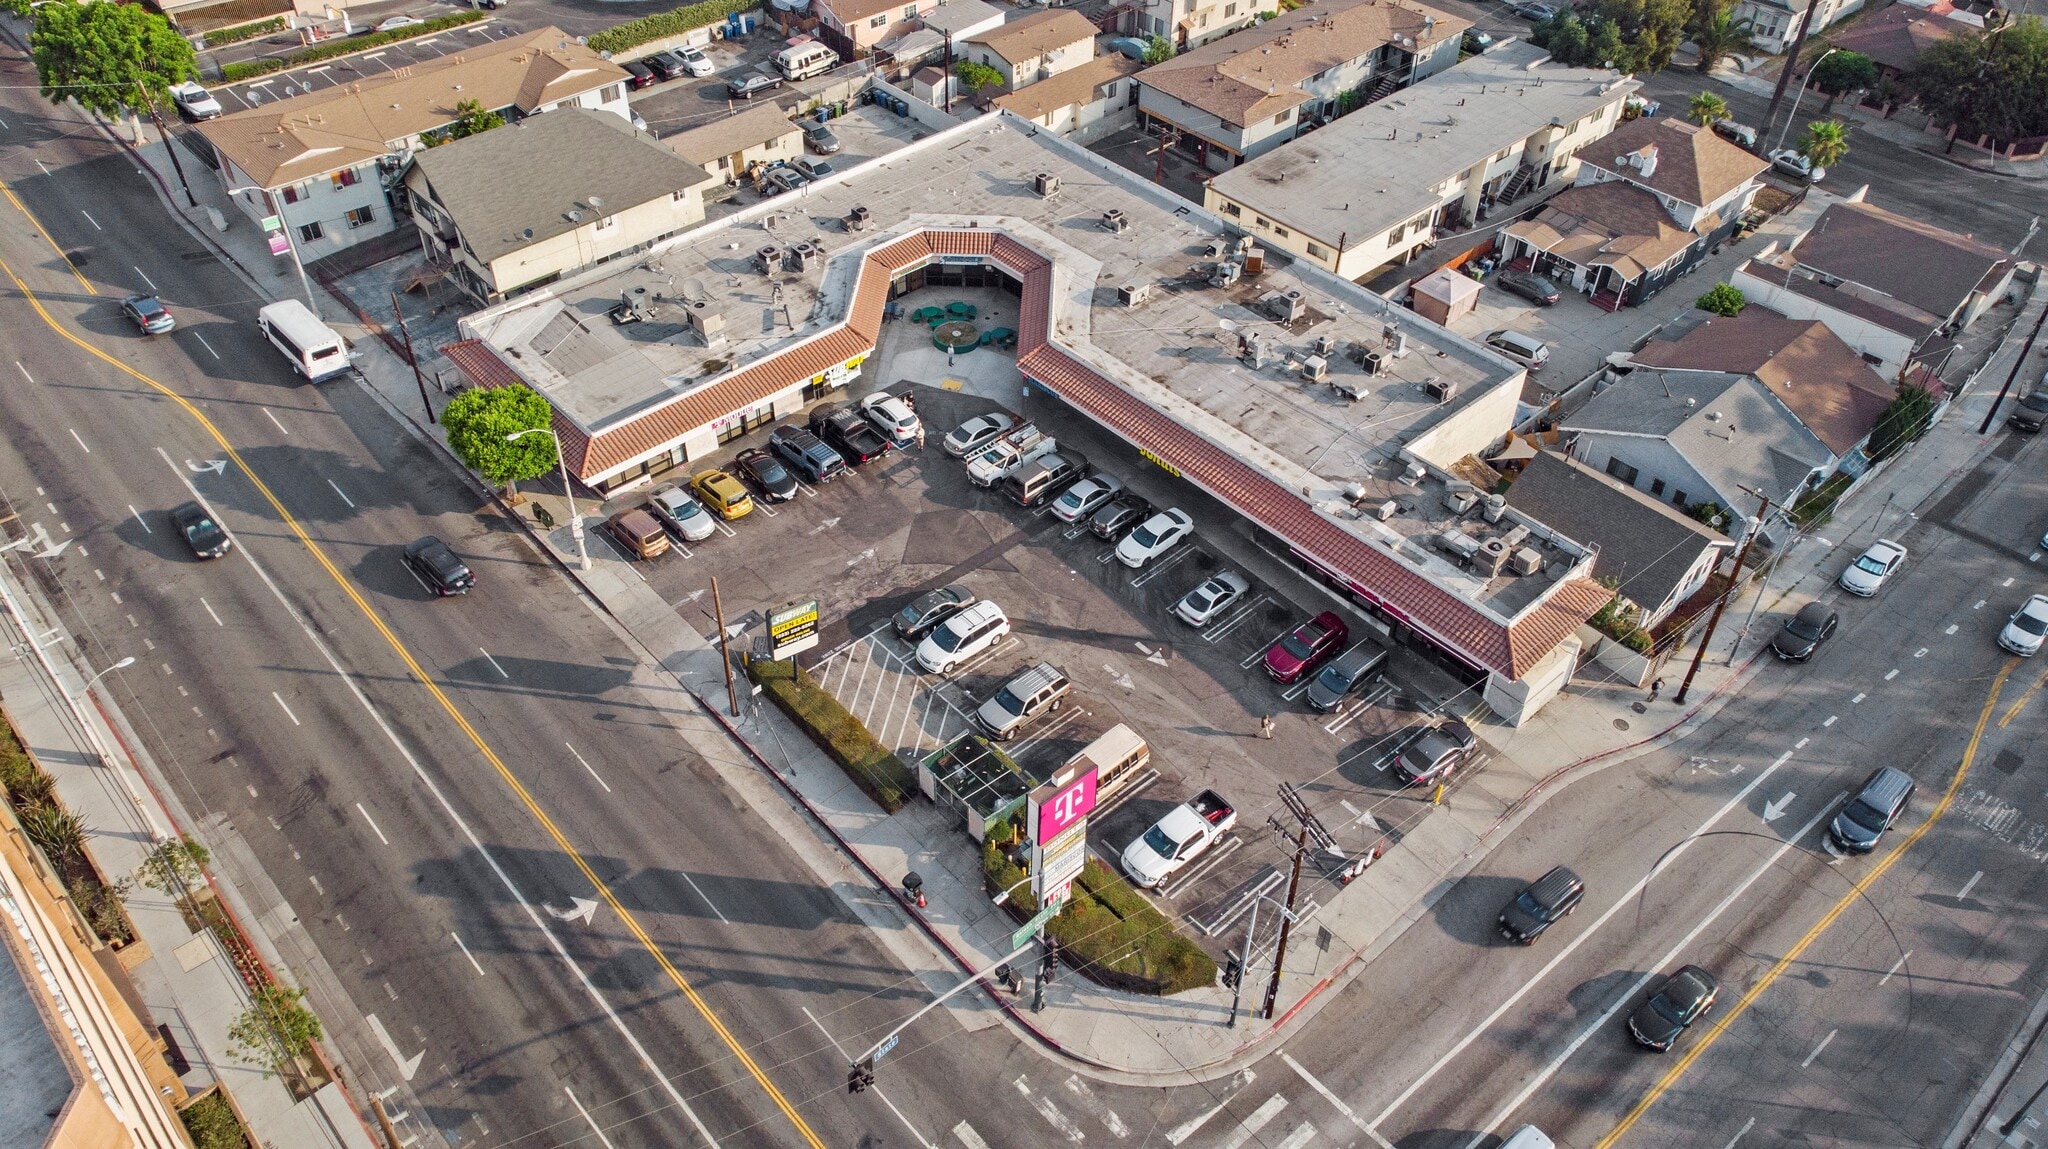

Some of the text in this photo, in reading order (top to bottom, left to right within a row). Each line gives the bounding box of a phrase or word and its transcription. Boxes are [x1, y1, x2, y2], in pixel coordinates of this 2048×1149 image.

[772, 601, 816, 625] SUBWAY
[774, 612, 816, 632] OPEN LATE!
[1054, 782, 1084, 826] T
[876, 1039, 897, 1058] State
